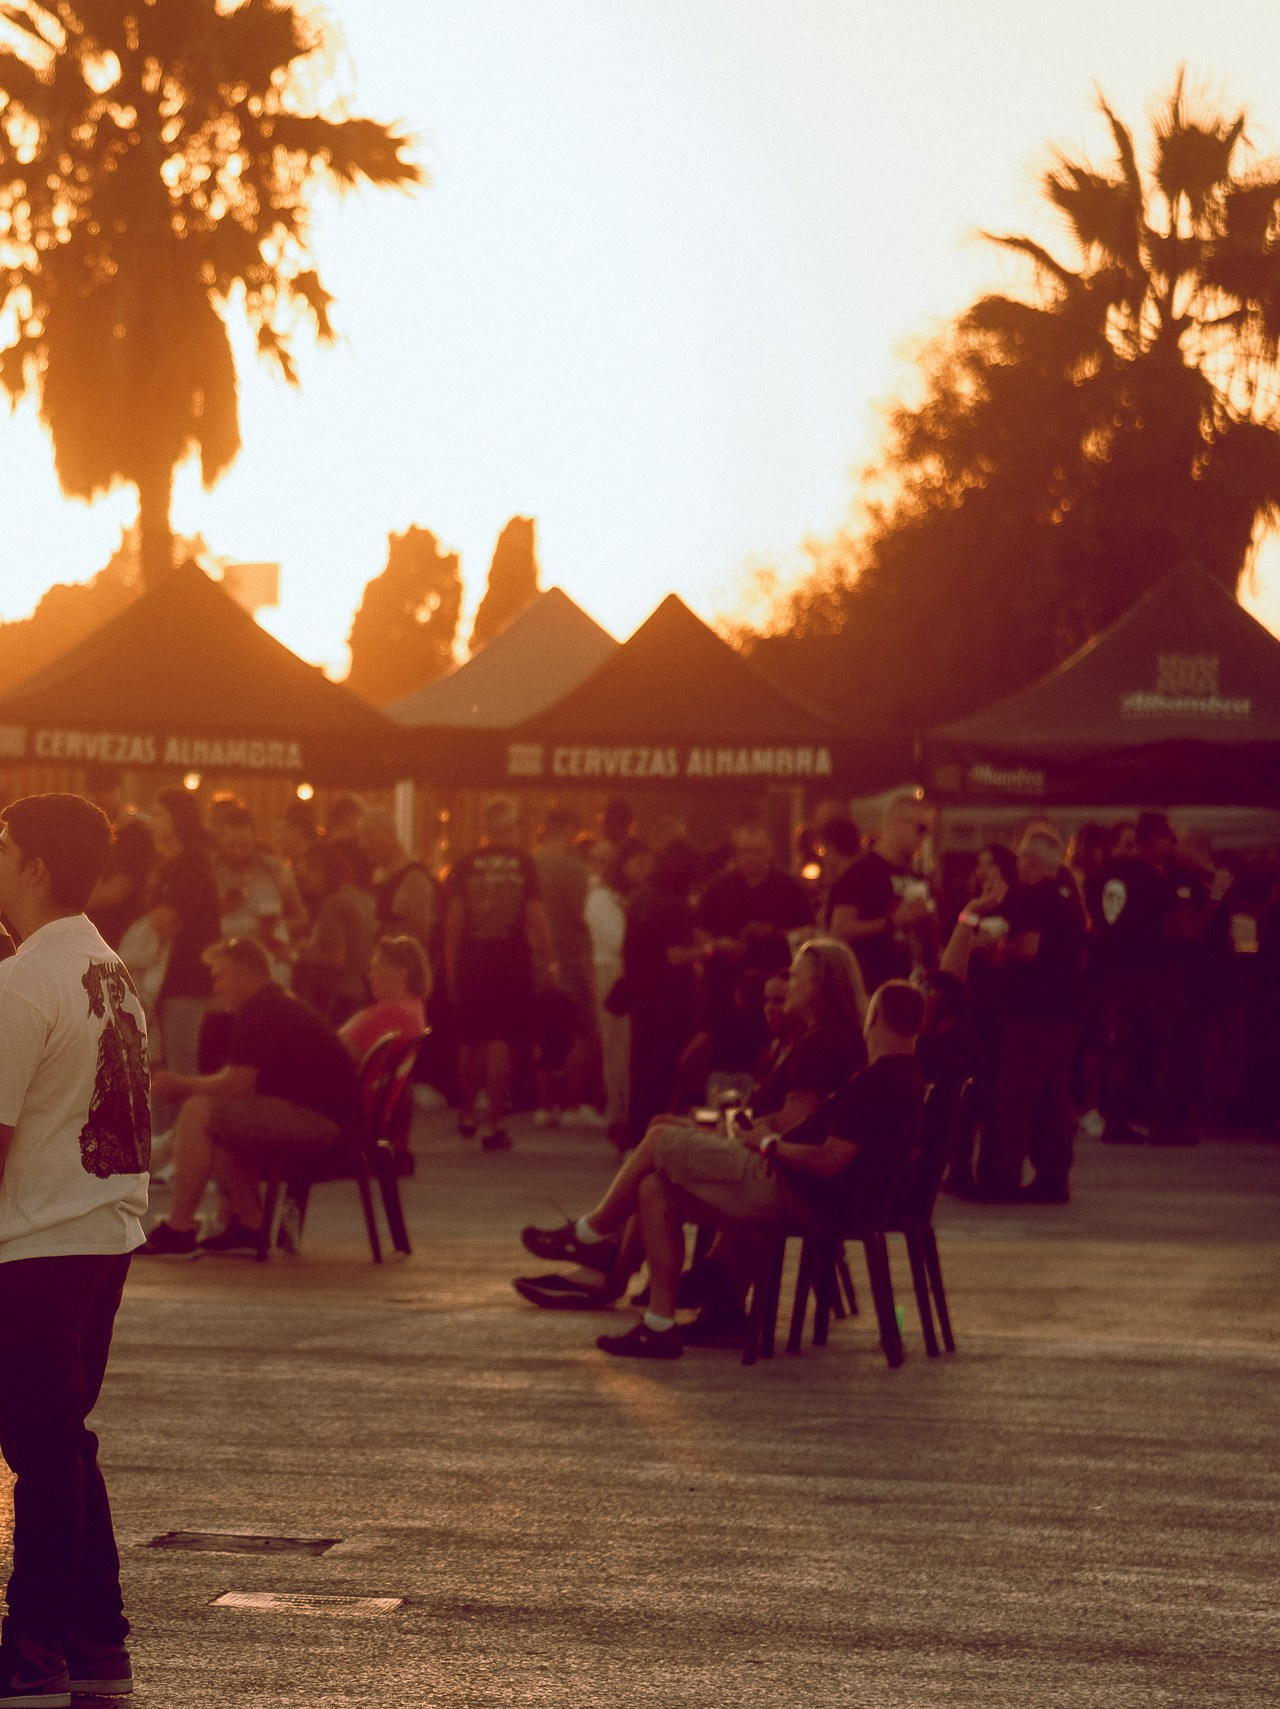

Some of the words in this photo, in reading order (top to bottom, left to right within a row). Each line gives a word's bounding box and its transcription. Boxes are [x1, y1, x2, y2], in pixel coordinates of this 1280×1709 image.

[35, 729, 157, 764] CERVEZAS
[163, 736, 302, 769] ALHAMBRA
[552, 747, 680, 777] CERVEZAS
[686, 748, 833, 777] ALHAMBRA
